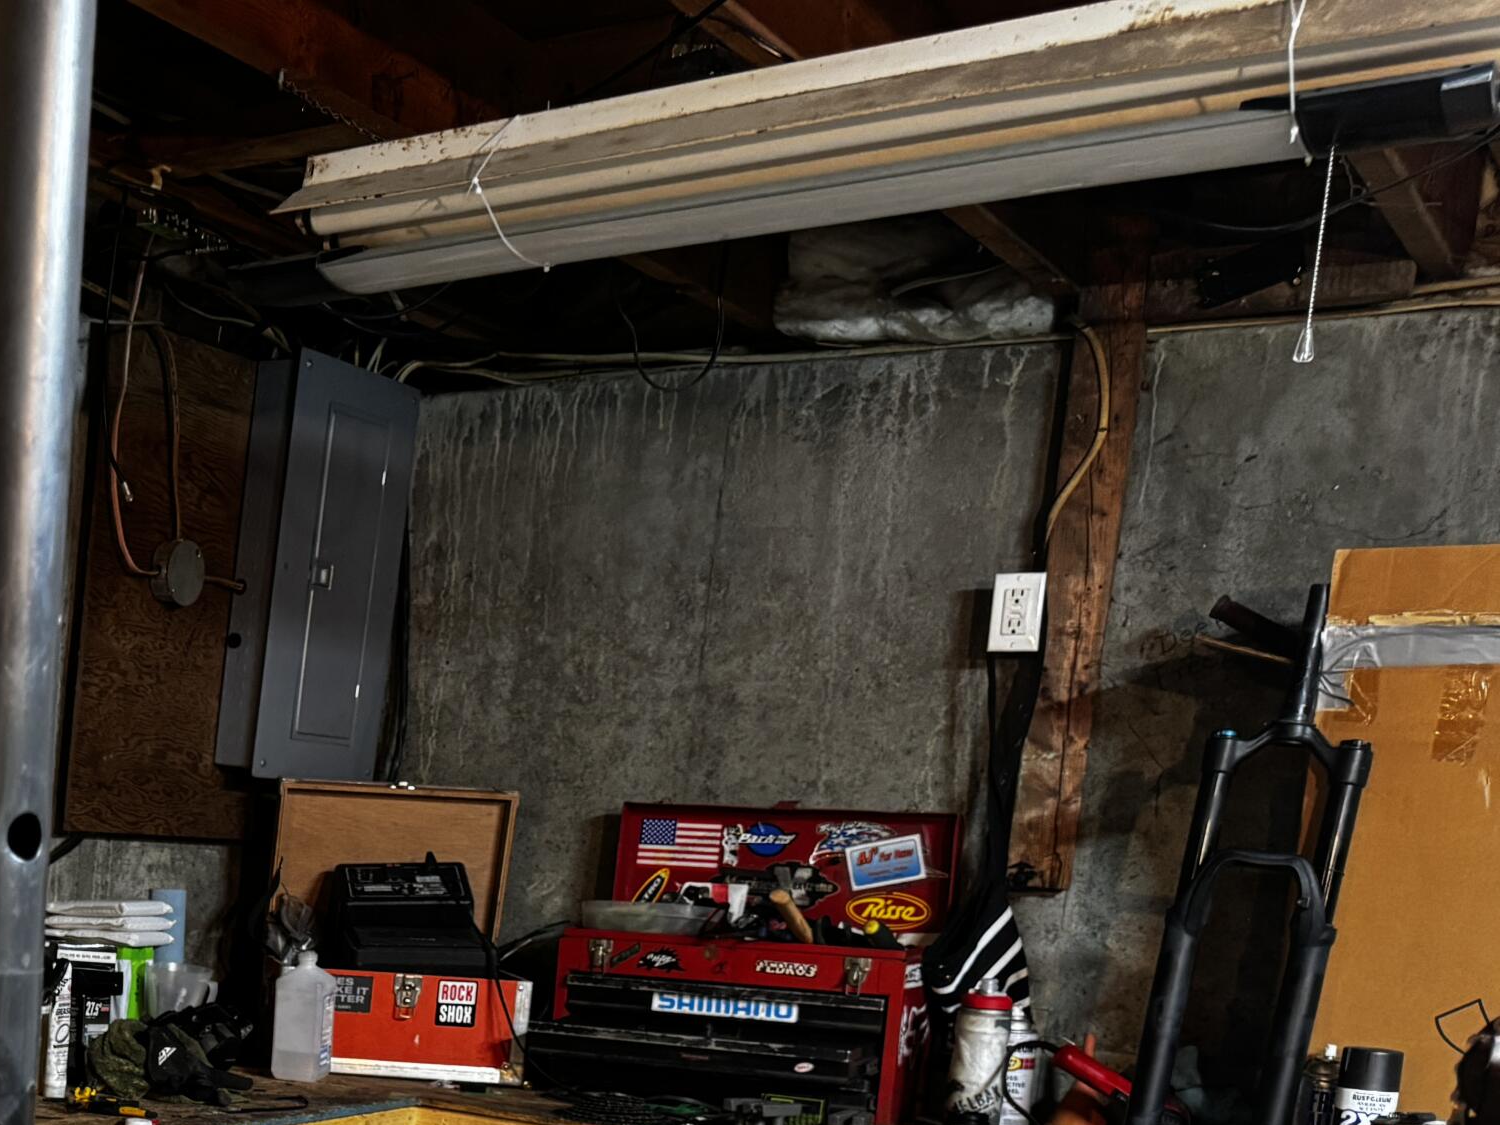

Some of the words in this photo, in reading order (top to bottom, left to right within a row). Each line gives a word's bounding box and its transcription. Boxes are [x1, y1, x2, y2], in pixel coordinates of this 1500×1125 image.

[861, 897, 916, 921] Risse
[441, 984, 473, 1001] ROCK
[439, 1005, 472, 1023] SHOX
[658, 993, 794, 1019] SHIMANO
